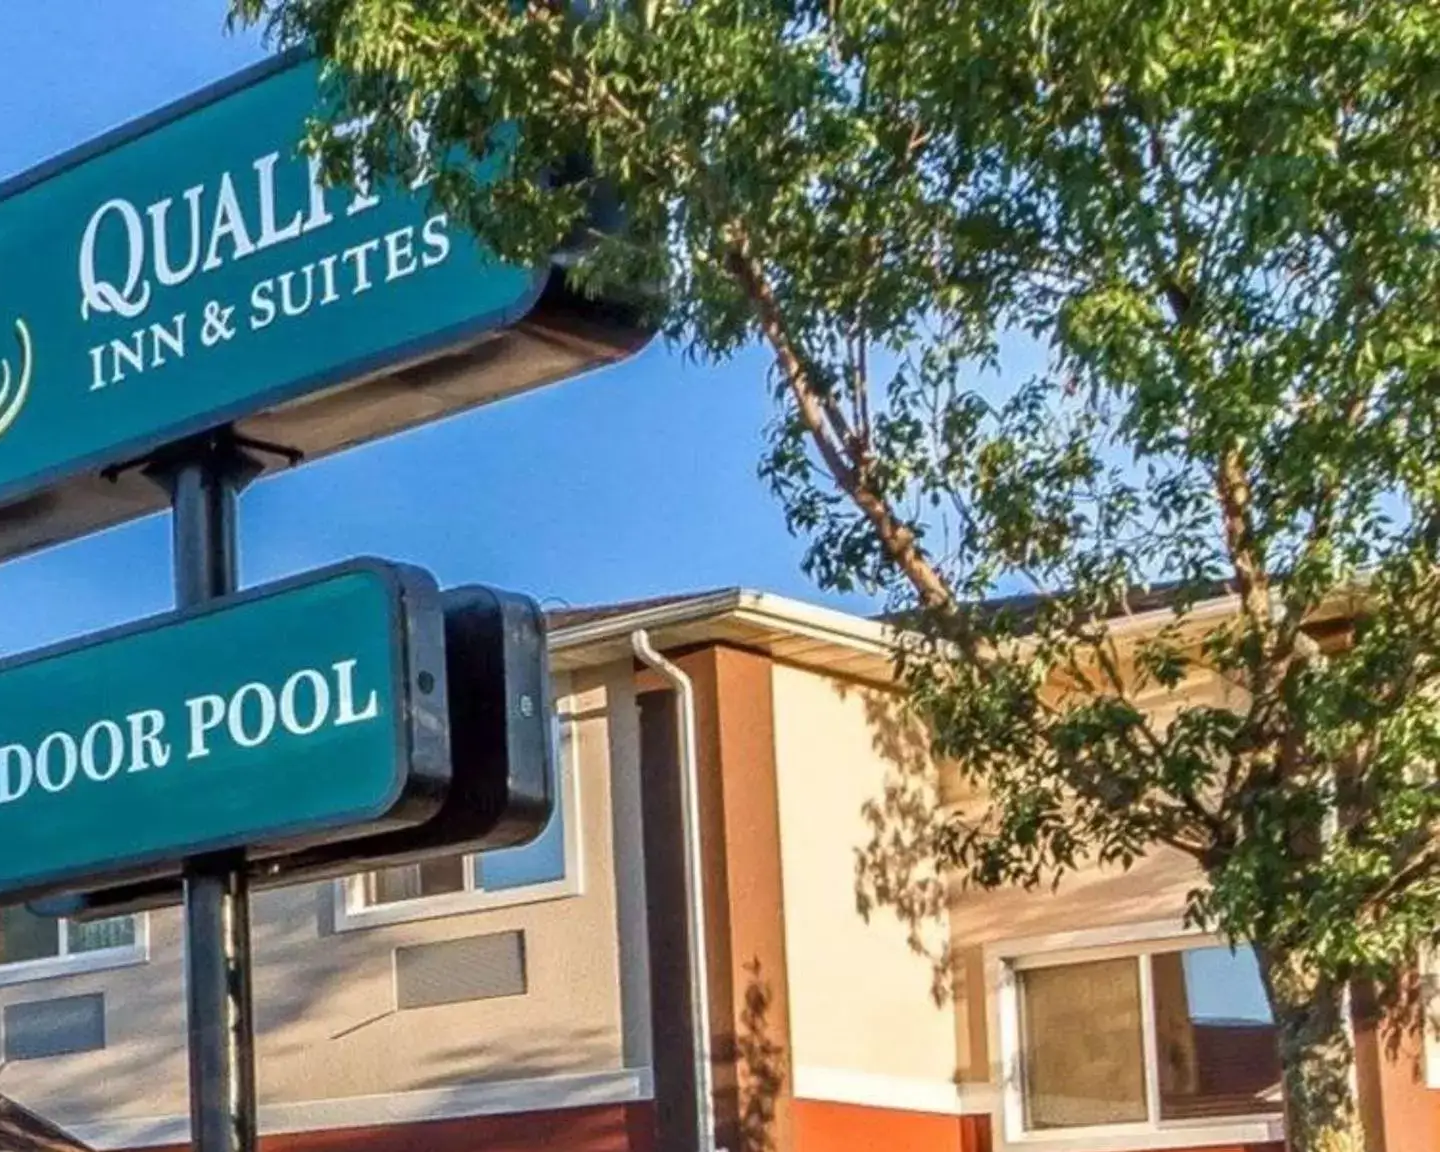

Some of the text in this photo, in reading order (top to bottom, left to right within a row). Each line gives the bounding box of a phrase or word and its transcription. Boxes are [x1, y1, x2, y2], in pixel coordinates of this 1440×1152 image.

[89, 214, 450, 391] INN & SUITES
[185, 659, 377, 760] POOL
